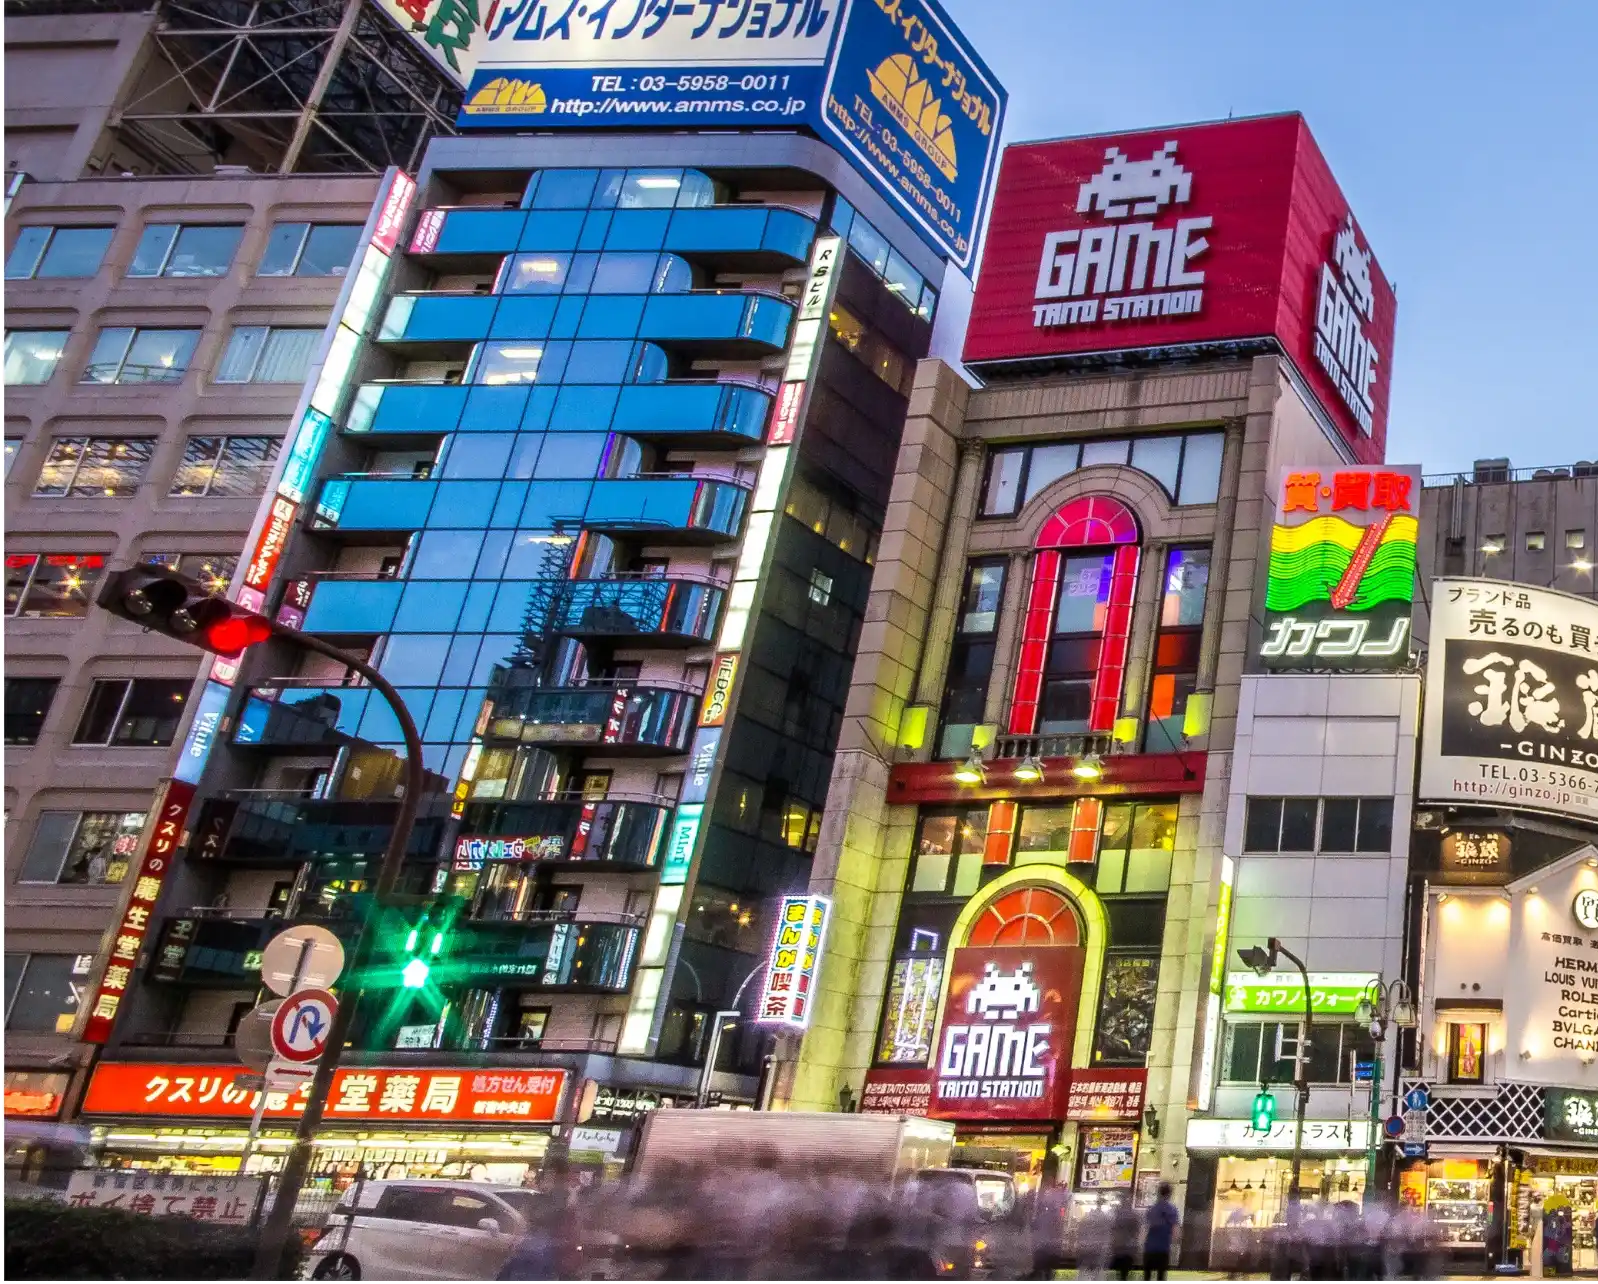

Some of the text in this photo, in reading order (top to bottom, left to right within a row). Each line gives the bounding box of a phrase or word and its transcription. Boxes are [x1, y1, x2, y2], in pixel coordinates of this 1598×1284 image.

[550, 97, 807, 116] http://www.amms.co.jp
[1035, 216, 1213, 300] GAME
[1033, 290, 1203, 327] TAITO STATION
[1316, 262, 1379, 416] GAME
[1314, 332, 1373, 438] TAITO STATION
[1448, 587, 1531, 610] ブランド品
[1260, 616, 1411, 657] カワノ
[1453, 780, 1571, 804] http://ginzo.jp
[1540, 932, 1584, 948] 高価買取
[766, 903, 807, 1016] まんが喫茶
[1545, 971, 1576, 987] LOUIS
[941, 1023, 1052, 1077] GAME
[472, 1075, 556, 1094] 処方せん受付
[938, 1081, 1044, 1098] TAITO STATION
[69, 1191, 247, 1220] ポイ捨て禁止
